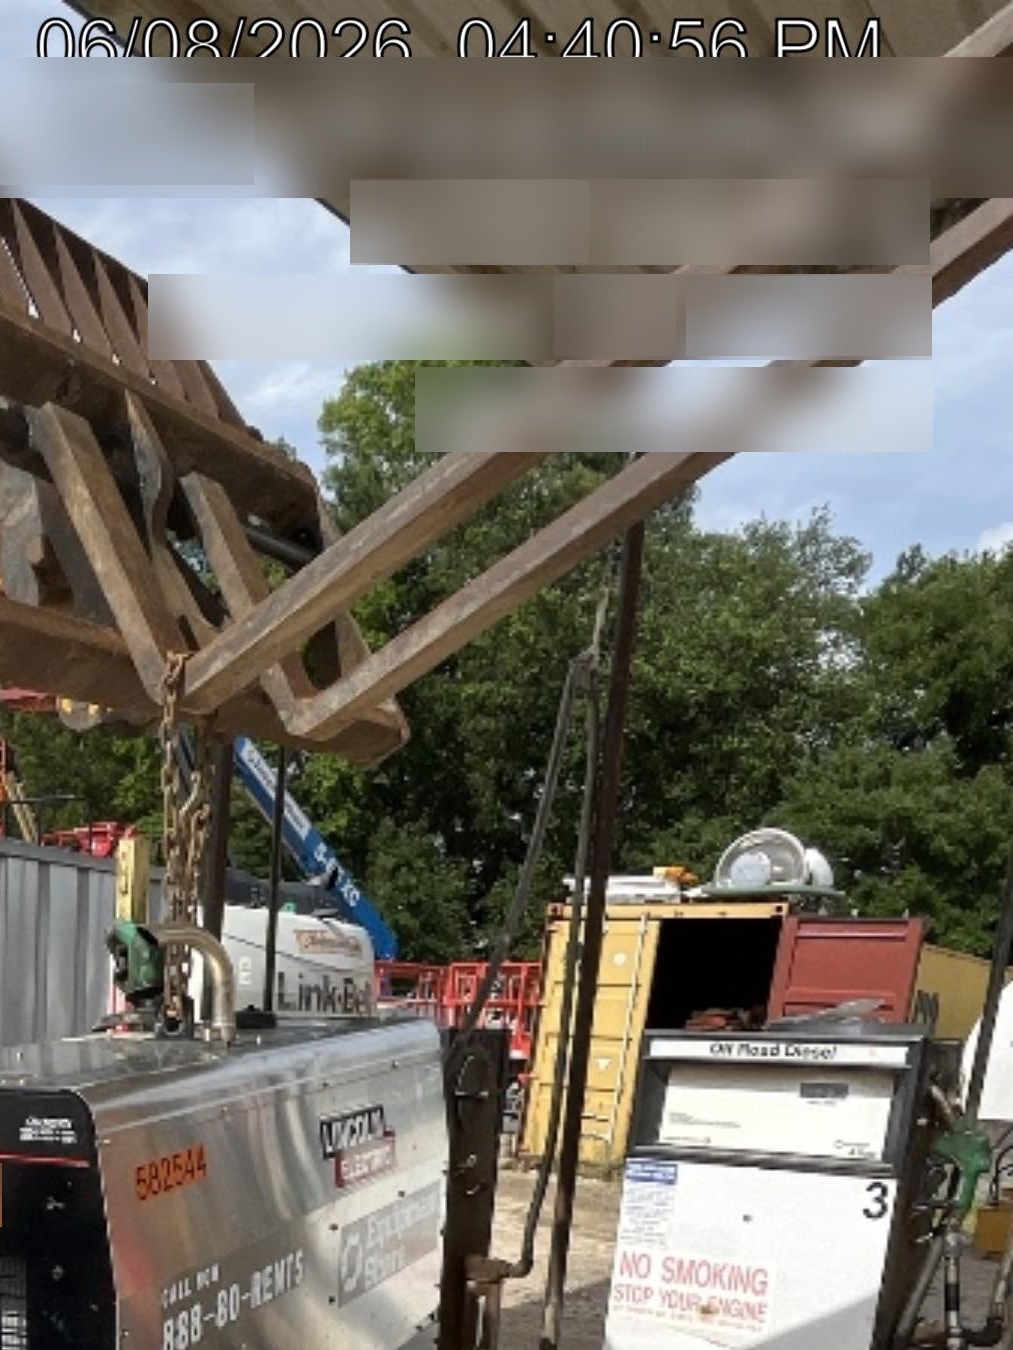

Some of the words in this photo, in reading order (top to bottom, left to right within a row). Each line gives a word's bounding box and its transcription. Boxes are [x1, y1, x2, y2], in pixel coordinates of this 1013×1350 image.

[277, 971, 372, 1013] Link-Bel
[135, 1143, 207, 1201] 582544
[862, 1181, 889, 1220] 3
[619, 1250, 652, 1280] NO
[661, 1255, 769, 1297] SMOKING
[613, 1283, 655, 1304] STOP
[659, 1287, 702, 1312] YOUR
